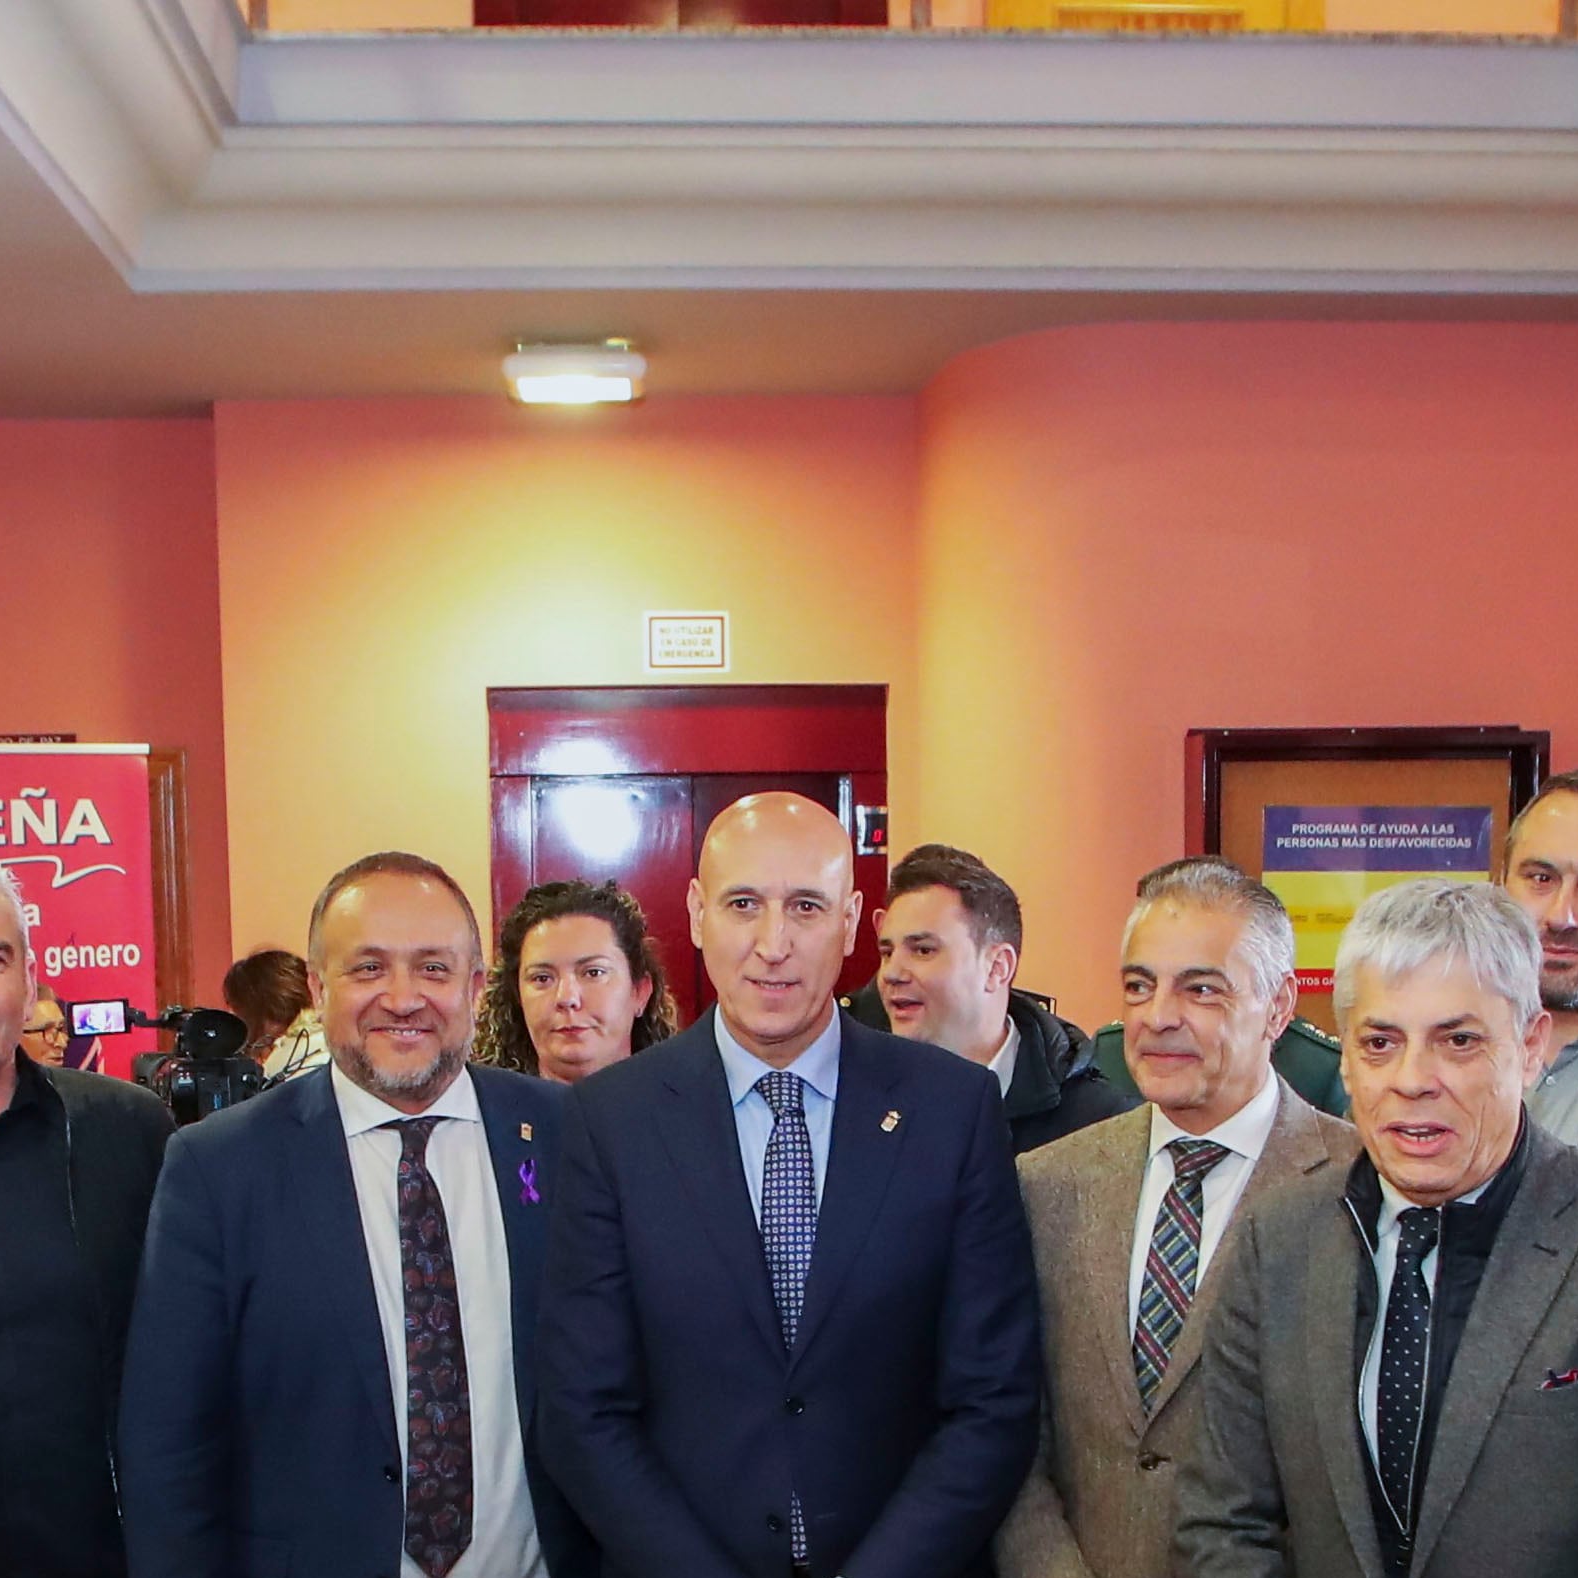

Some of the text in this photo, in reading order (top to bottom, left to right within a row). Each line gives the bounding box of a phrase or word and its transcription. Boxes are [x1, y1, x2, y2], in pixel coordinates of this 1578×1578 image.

[1291, 823, 1455, 835] PROGRAMA DE AYUDA A LAS
[1276, 837, 1339, 848] PERSONAS
[1369, 836, 1472, 848] DESFAVORECIDAS
